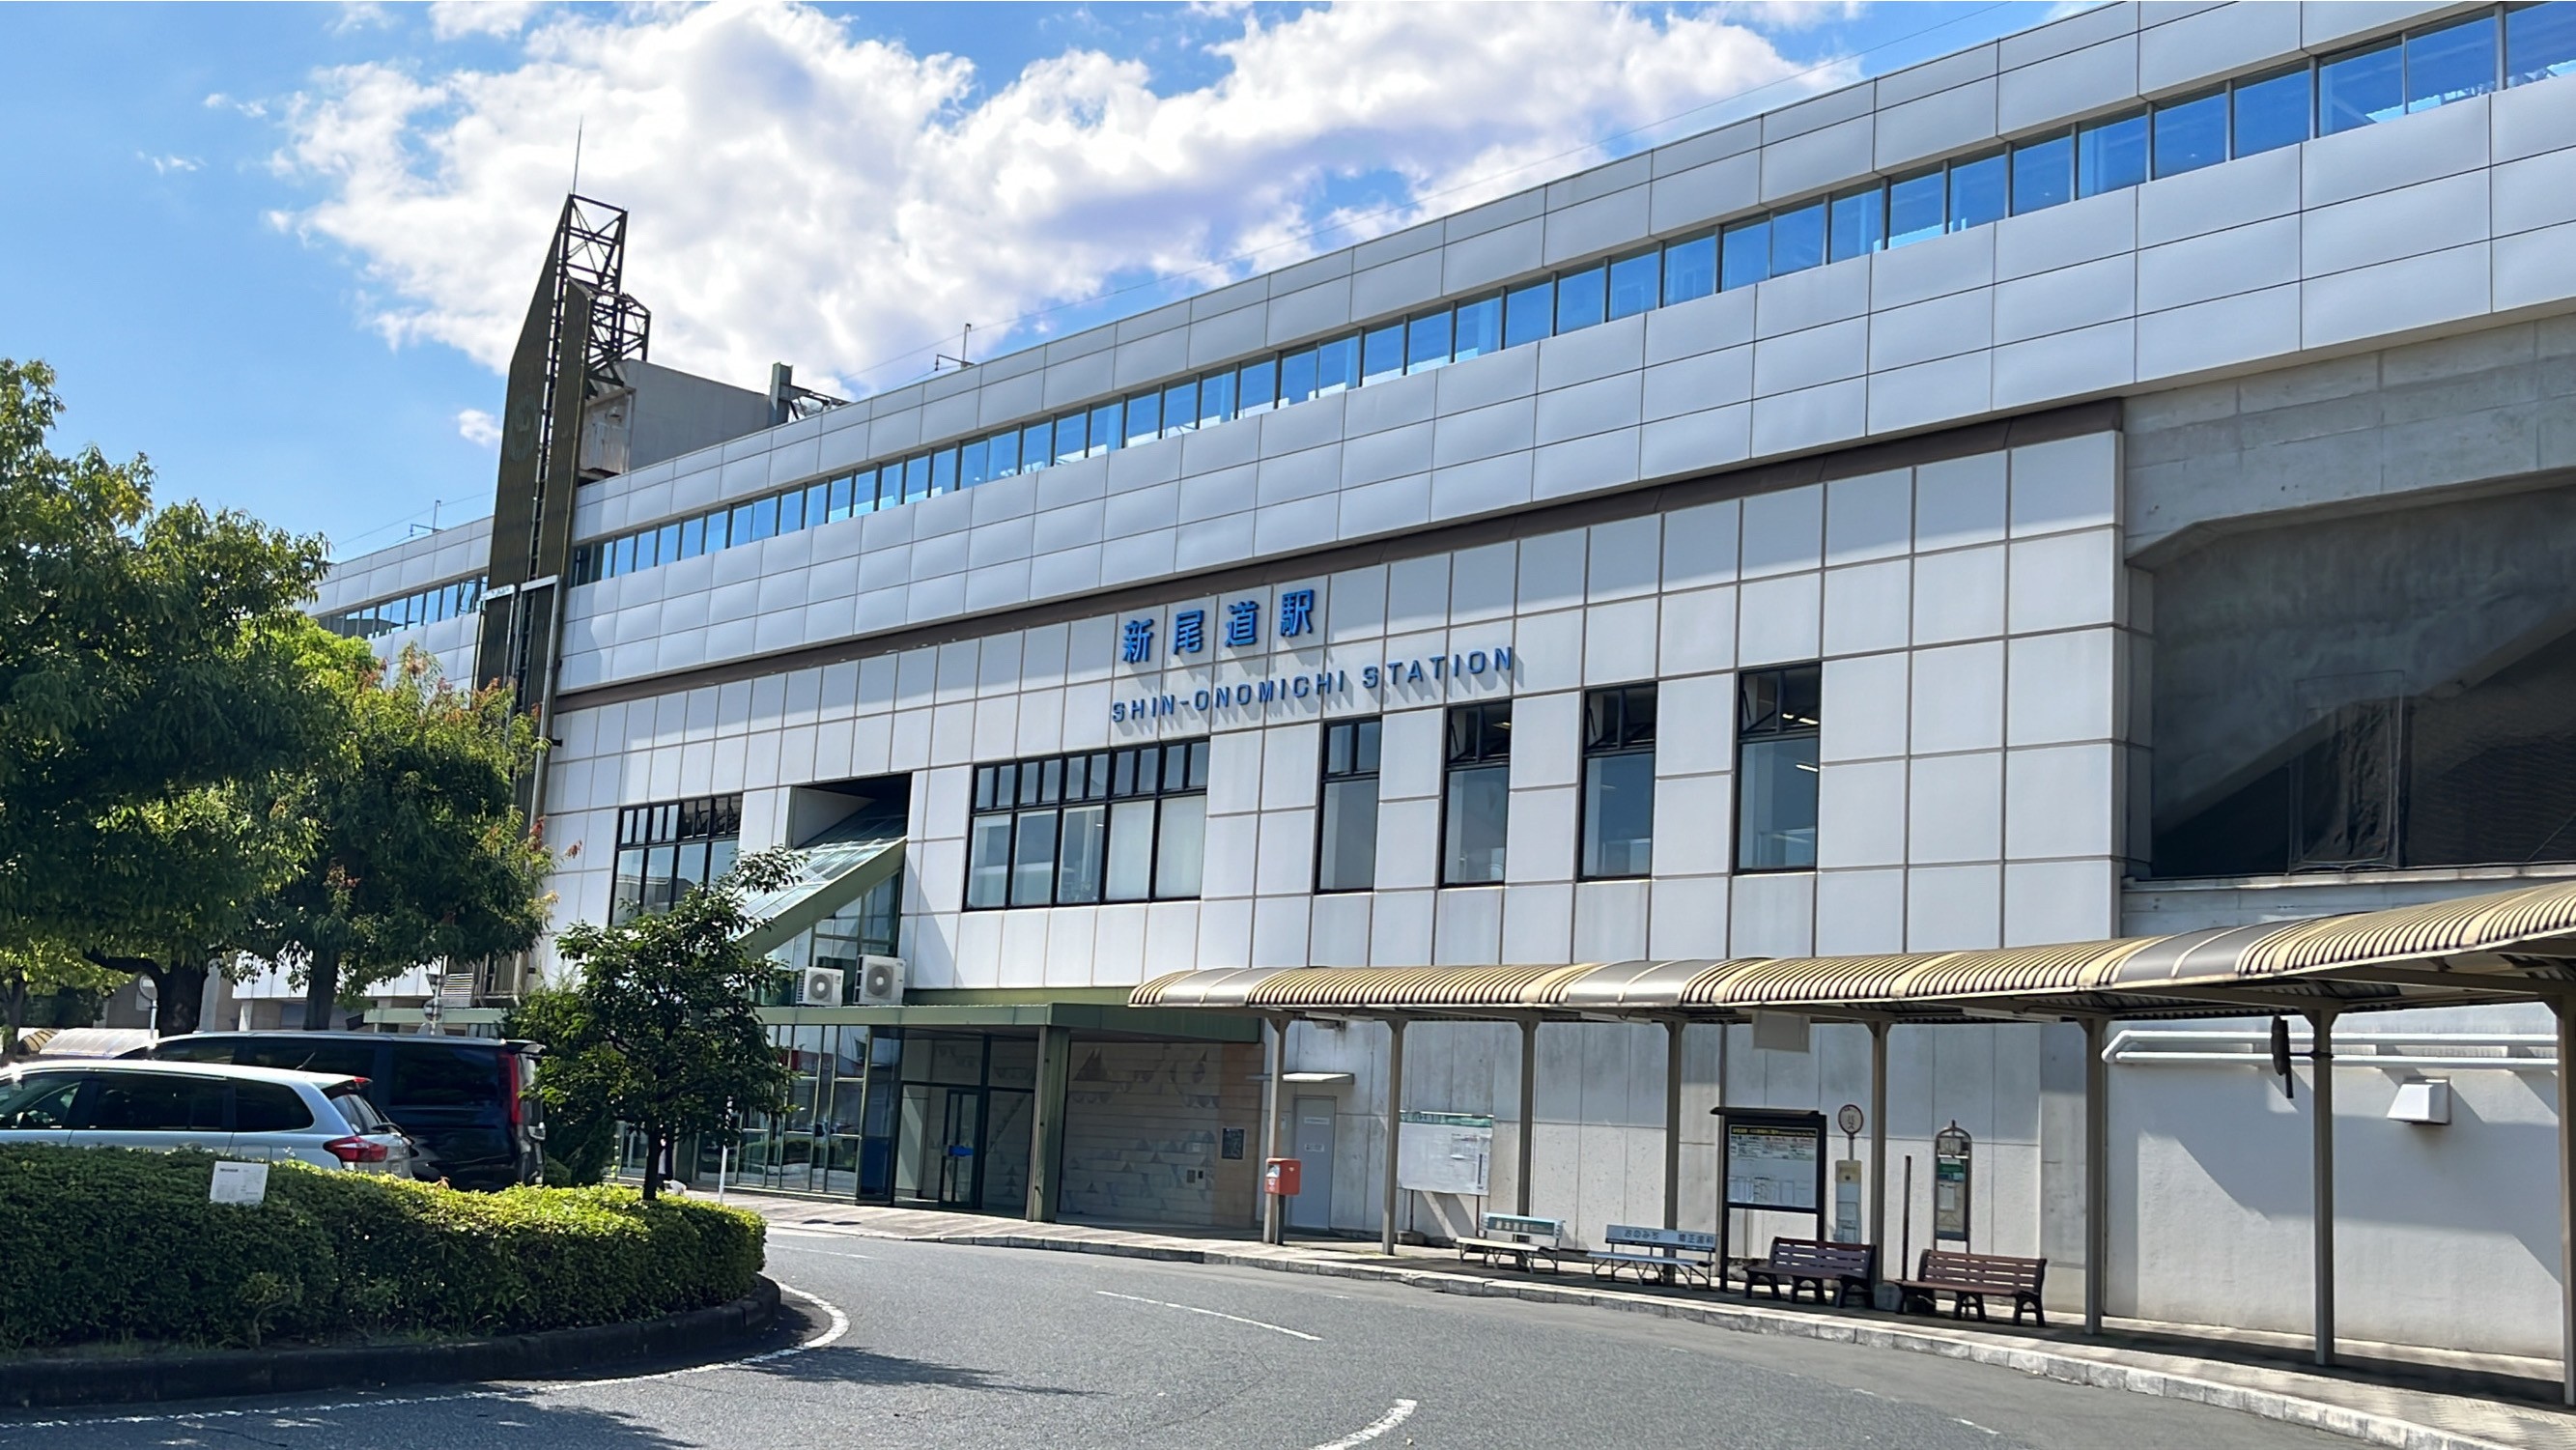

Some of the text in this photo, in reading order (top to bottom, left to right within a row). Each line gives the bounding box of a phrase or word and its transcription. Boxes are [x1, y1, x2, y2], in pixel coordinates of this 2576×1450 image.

[1120, 587, 1315, 664] 新尾道駅
[1112, 646, 1514, 723] SHIN-ONOMICHI STATION
